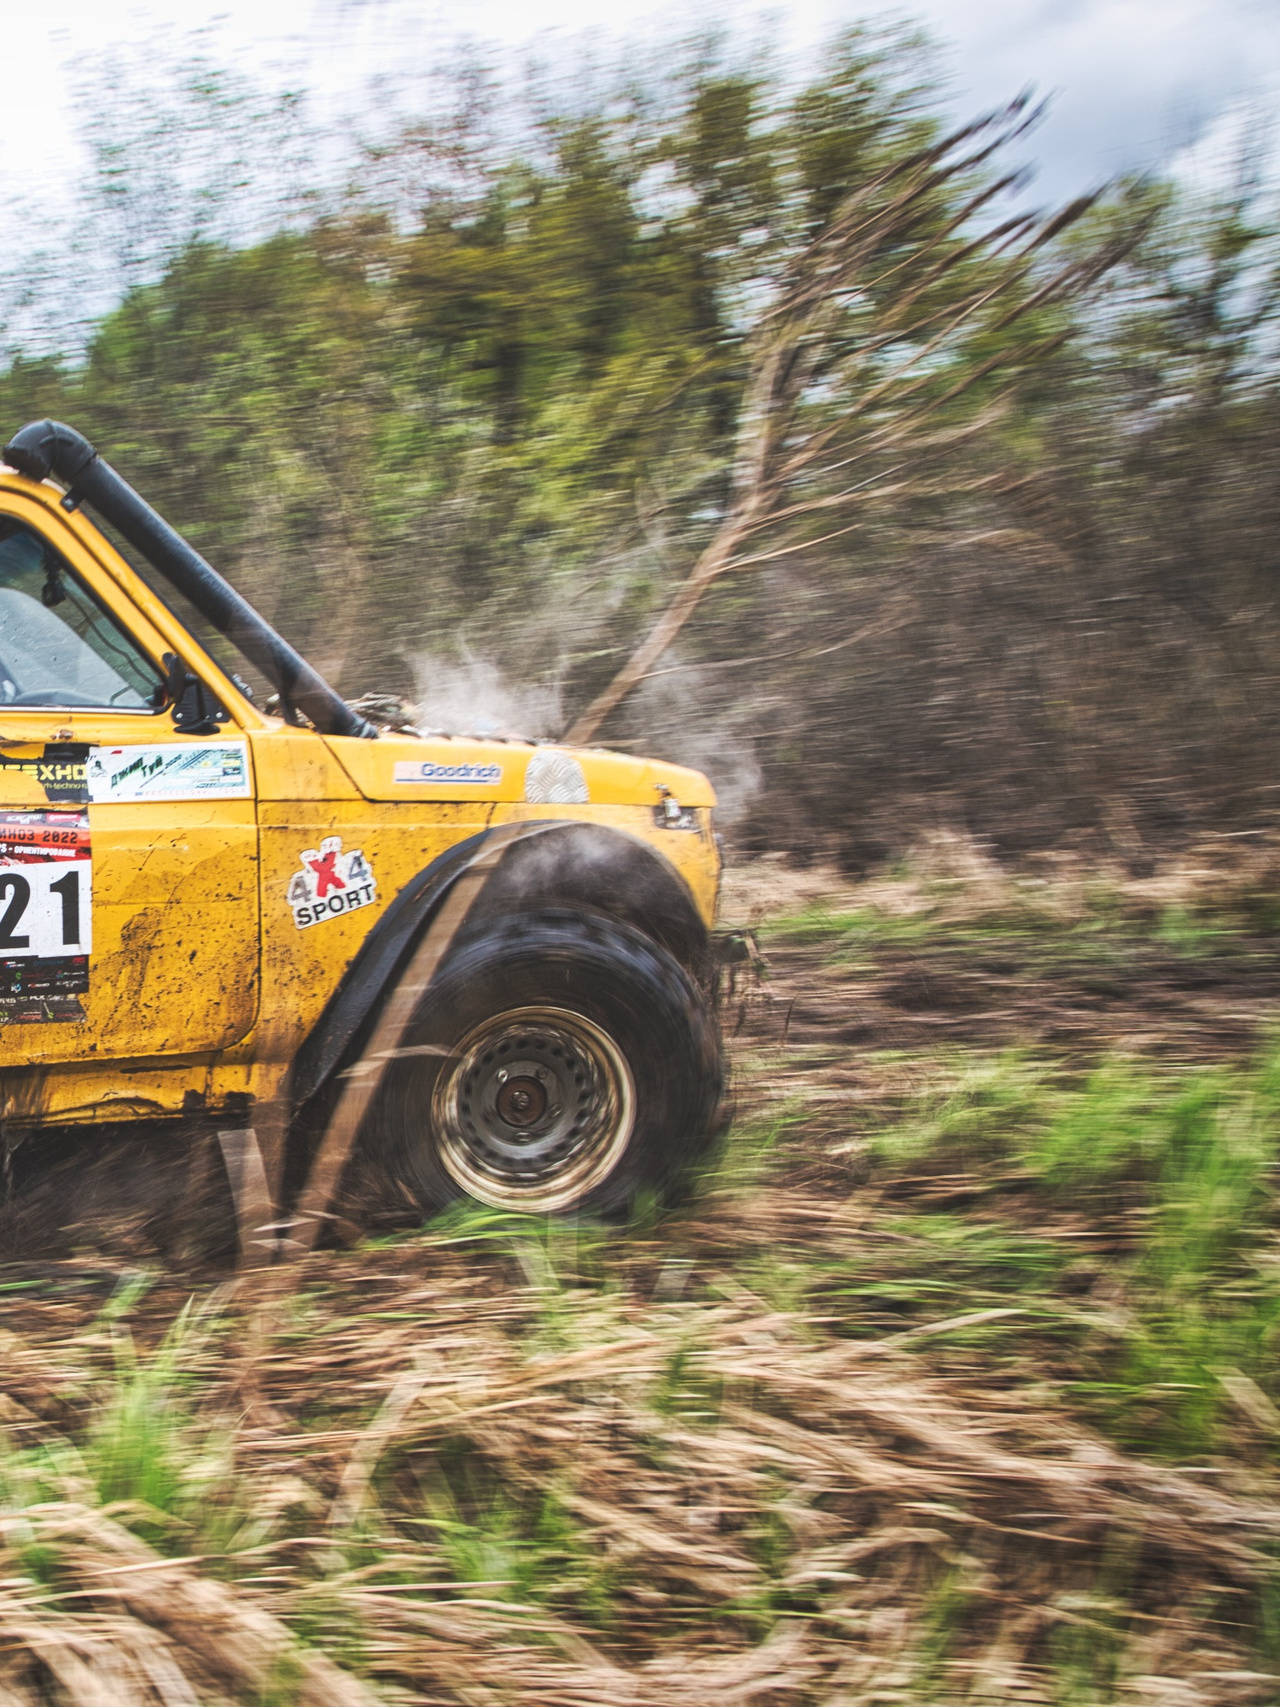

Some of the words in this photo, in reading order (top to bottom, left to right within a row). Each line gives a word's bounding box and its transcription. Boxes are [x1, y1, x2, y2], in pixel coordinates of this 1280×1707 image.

[422, 763, 501, 777] Goodrich
[43, 830, 78, 844] 2022
[14, 845, 76, 857] ОРИЕНТИРОВАНИЕ
[297, 884, 372, 925] SPORT
